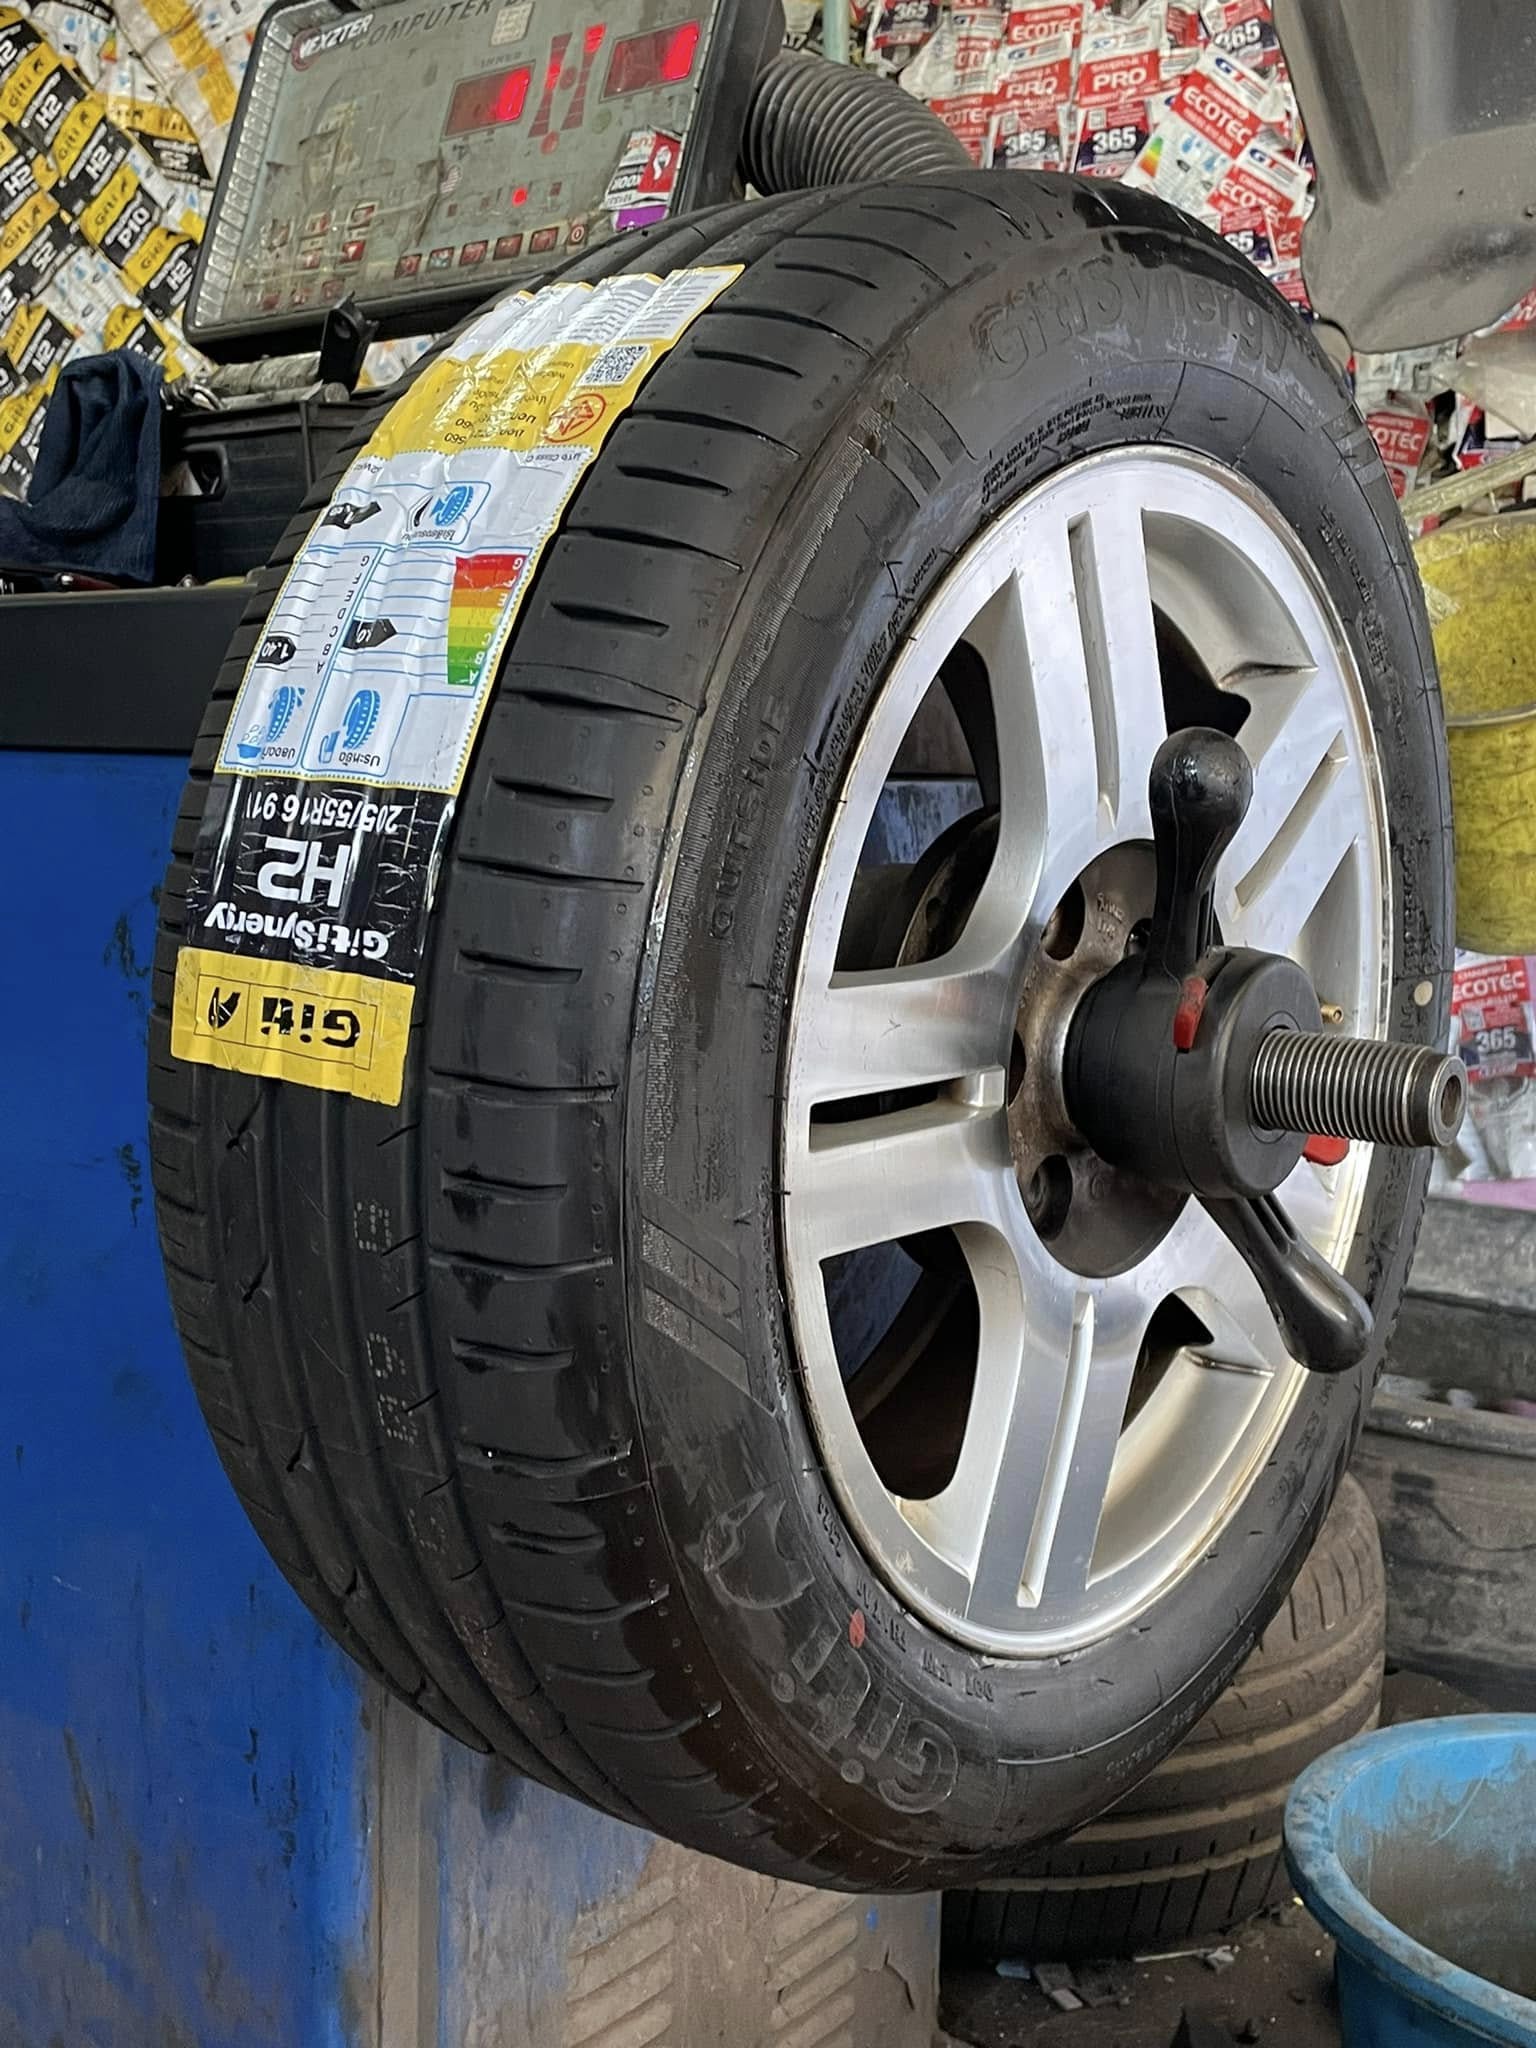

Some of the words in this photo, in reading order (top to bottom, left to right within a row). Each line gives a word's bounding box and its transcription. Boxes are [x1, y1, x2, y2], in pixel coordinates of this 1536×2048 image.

[1012, 17, 1083, 42] ECOTEC
[1092, 66, 1147, 92] PRO
[35, 94, 63, 129] H2
[938, 107, 991, 125] COTEC
[1183, 87, 1252, 146] ECOTEC
[1005, 129, 1046, 156] 365
[1092, 126, 1137, 152] 365
[85, 145, 113, 181] H2
[3, 162, 33, 197] H2
[117, 207, 150, 250] P10
[1223, 229, 1255, 252] 65
[32, 339, 56, 373] H2
[1369, 425, 1422, 450] OTEC
[360, 556, 370, 567] G
[513, 557, 524, 570] G
[497, 594, 508, 606] E
[337, 608, 347, 620] D
[329, 626, 339, 638] C
[261, 643, 290, 660] 1.40
[322, 643, 331, 656] B
[473, 652, 484, 665] B
[316, 661, 326, 674] A
[468, 669, 480, 683] A
[281, 793, 400, 833] 205/55R16
[257, 836, 350, 908] H2
[203, 900, 390, 960] GitiSynergy
[261, 996, 361, 1049] Giti
[1475, 1025, 1517, 1054] 365
